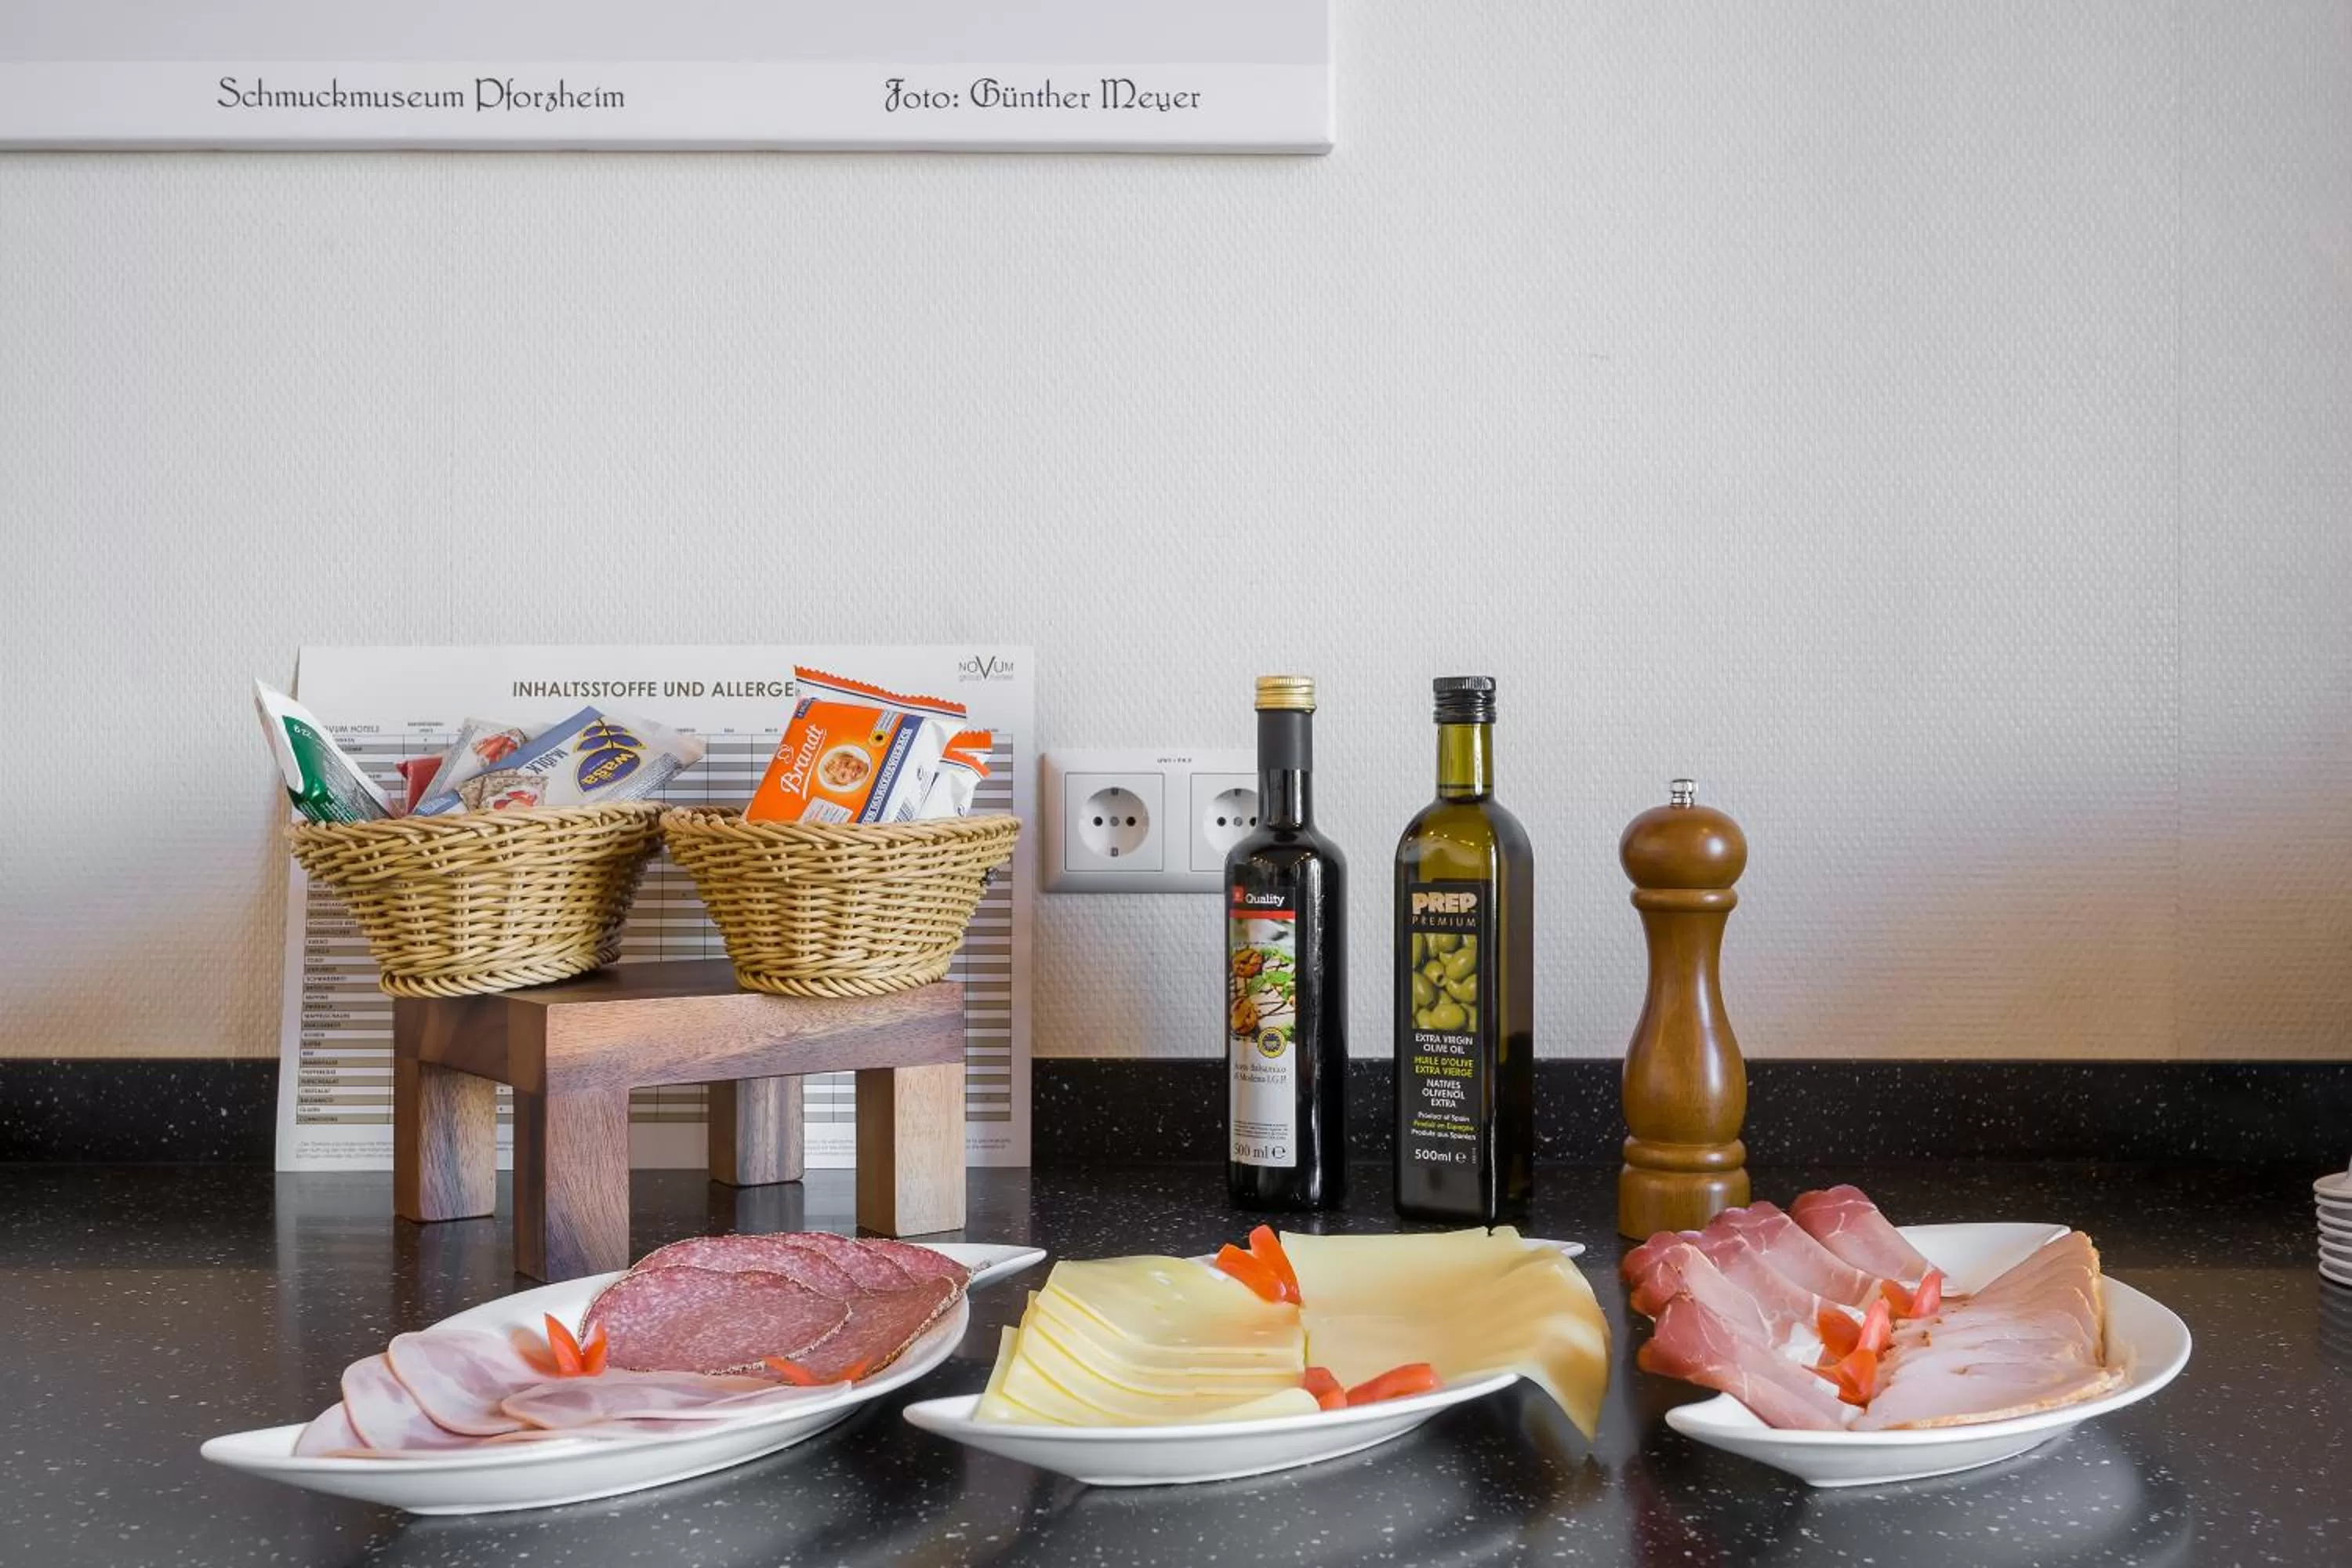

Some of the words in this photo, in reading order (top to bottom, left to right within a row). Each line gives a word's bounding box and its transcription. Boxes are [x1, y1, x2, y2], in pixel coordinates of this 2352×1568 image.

[217, 77, 465, 108] Schmuckmuseum
[475, 78, 626, 111] Pforzheim
[884, 79, 960, 112] Foto:
[970, 79, 1091, 109] Günther
[1102, 79, 1201, 111] Meyer
[513, 681, 656, 697] INHALTSSTOFFE
[664, 681, 705, 697] UND
[711, 681, 796, 697] ALLERGE
[780, 724, 825, 794] Brandt
[1245, 893, 1285, 907] Quality
[1412, 891, 1477, 915] PREP
[1412, 915, 1476, 927] PREMIUM
[1415, 1033, 1440, 1044] EXTRA
[1443, 1035, 1473, 1045] VIRGIN
[1423, 1044, 1447, 1052] OLIVE
[1450, 1045, 1465, 1054] OIL
[1414, 1056, 1439, 1065] HUILE
[1415, 1065, 1440, 1075] EXTRA
[1443, 1067, 1473, 1078] VIERGE
[1426, 1078, 1461, 1089] NATIVES
[1431, 1098, 1456, 1108] EXTRA
[1253, 1145, 1269, 1159] ml
[1414, 1148, 1452, 1162] 500ml
